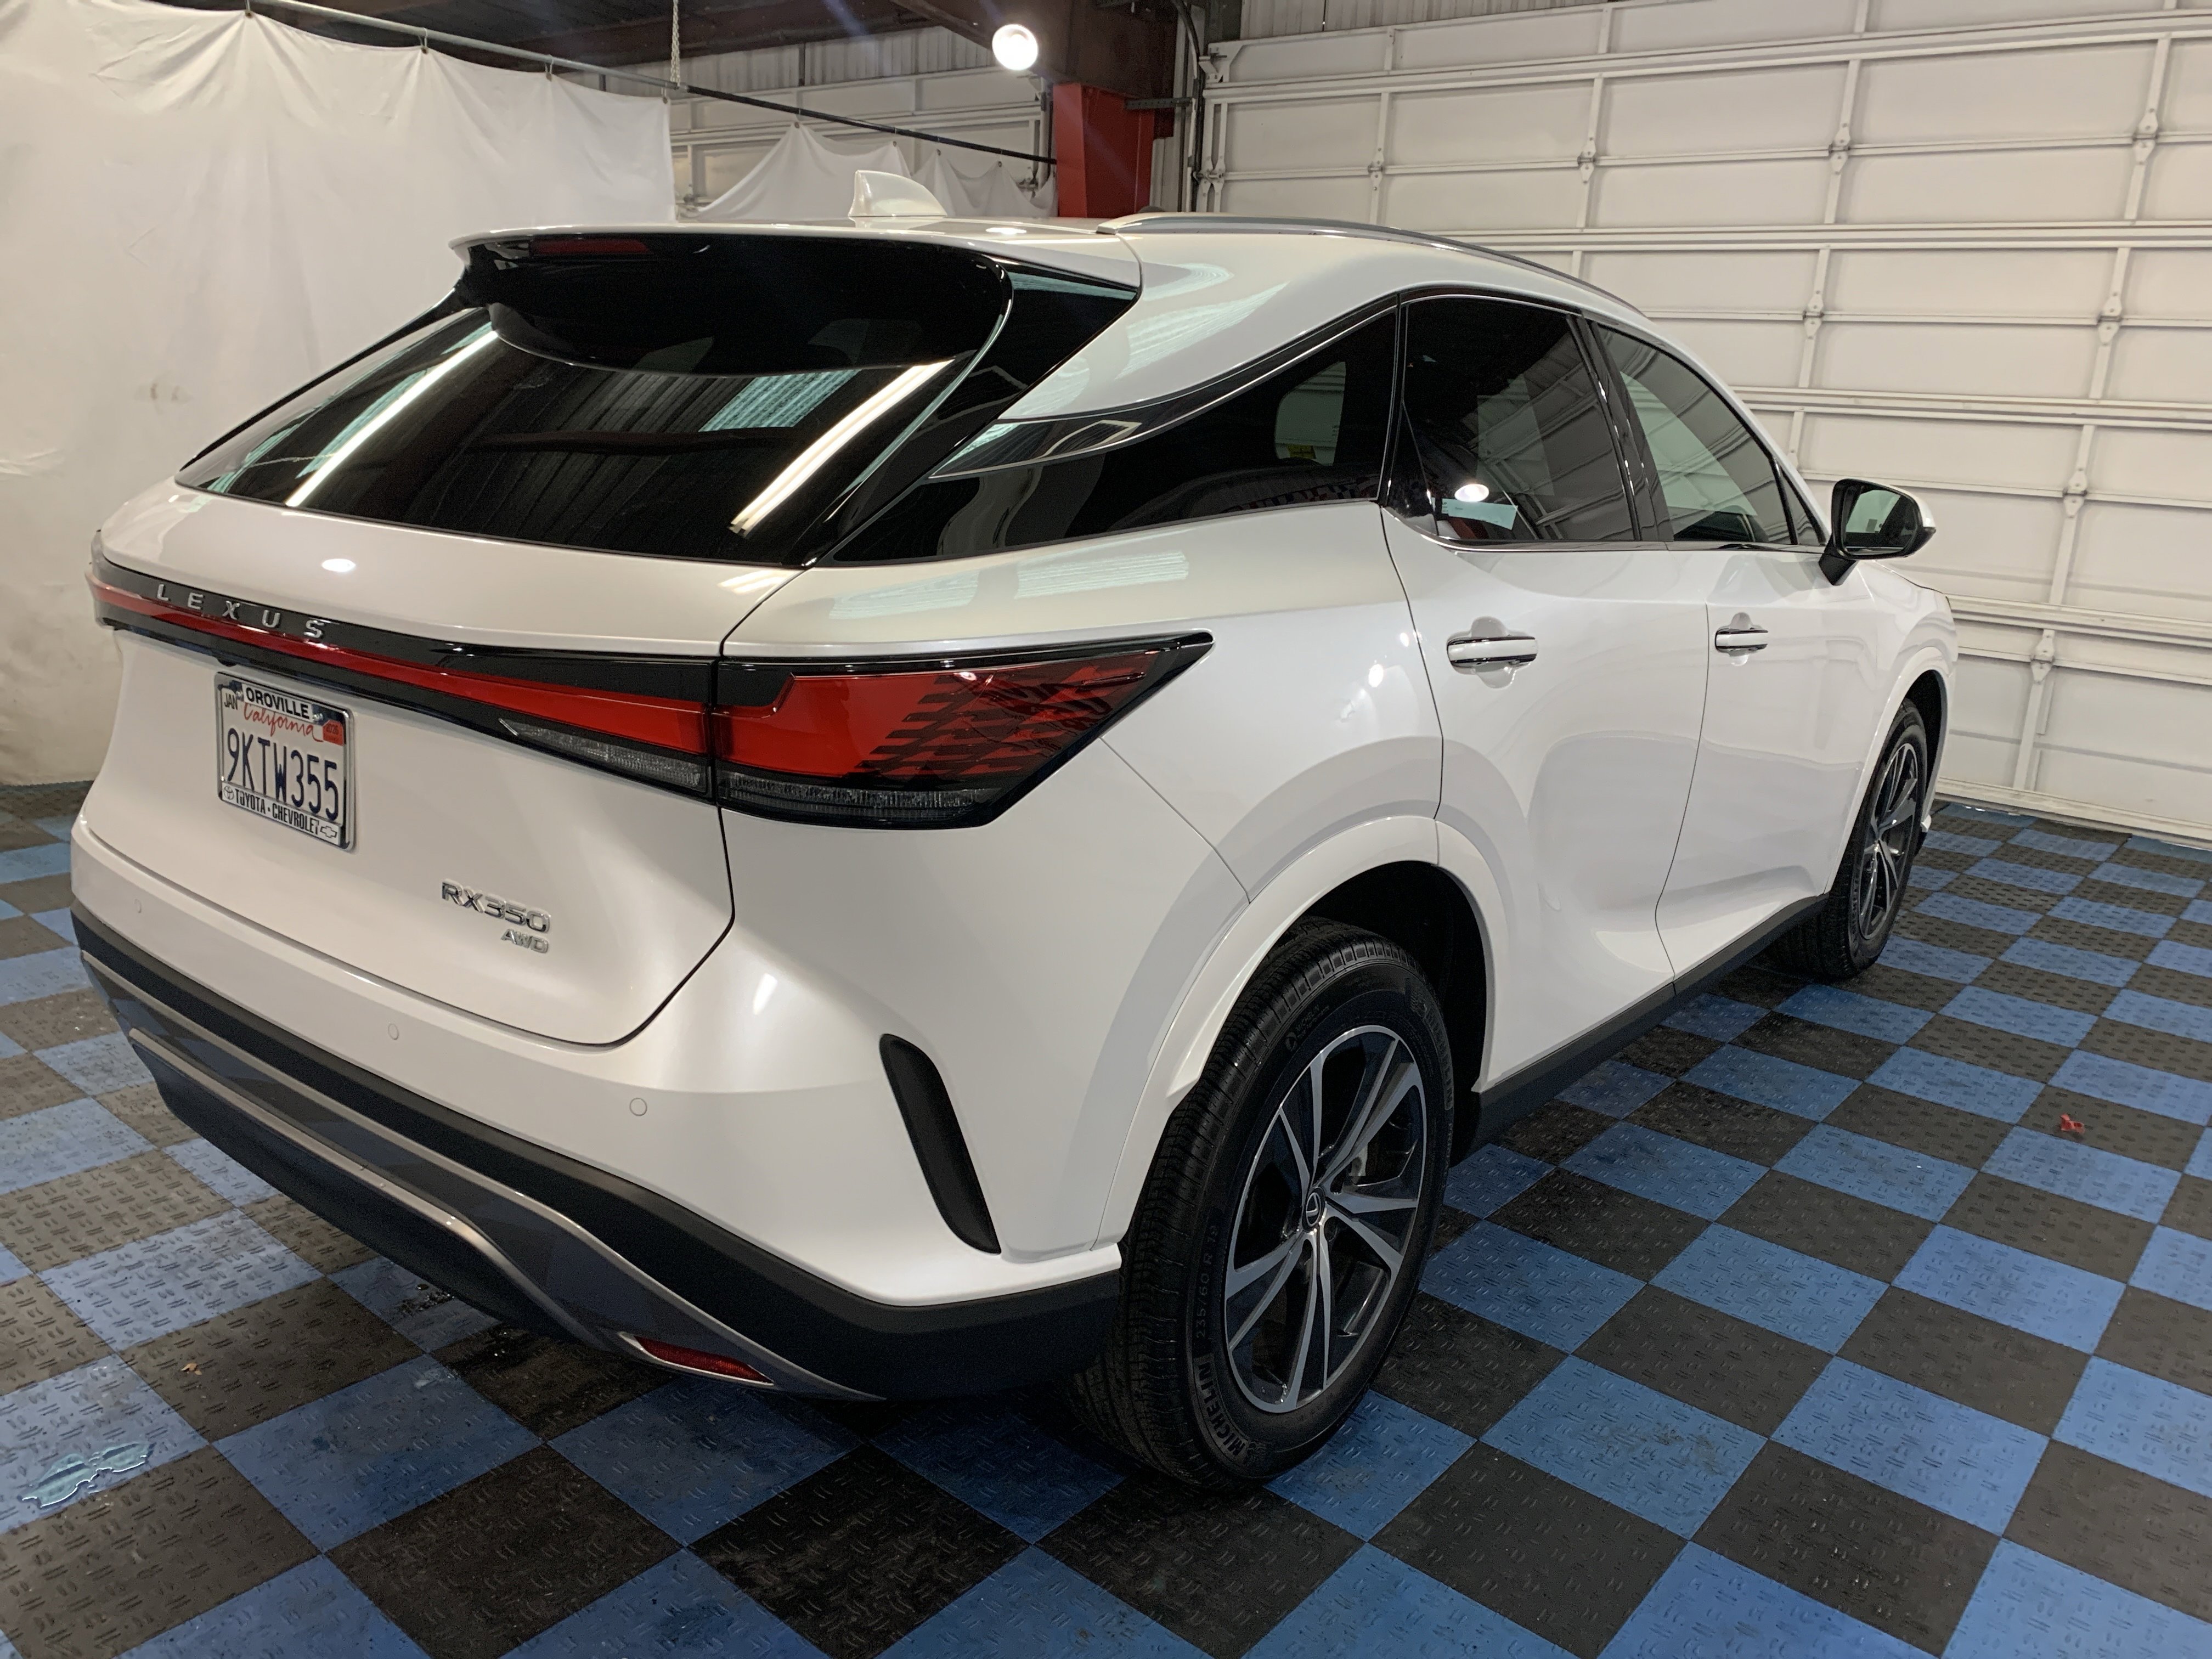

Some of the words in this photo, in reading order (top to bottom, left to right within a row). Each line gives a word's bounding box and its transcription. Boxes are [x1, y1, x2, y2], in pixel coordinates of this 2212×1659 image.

[157, 584, 326, 639] LEXUS
[224, 693, 238, 710] JAN
[244, 702, 324, 742] California
[246, 687, 310, 719] OROVILLE
[227, 727, 338, 821] 9KTW355
[235, 788, 266, 815] TOYOTA
[272, 803, 320, 834] CHEVROLET
[442, 878, 551, 933] RX350
[500, 929, 549, 953] AWD
[1198, 1362, 1246, 1457] MICHELIN
